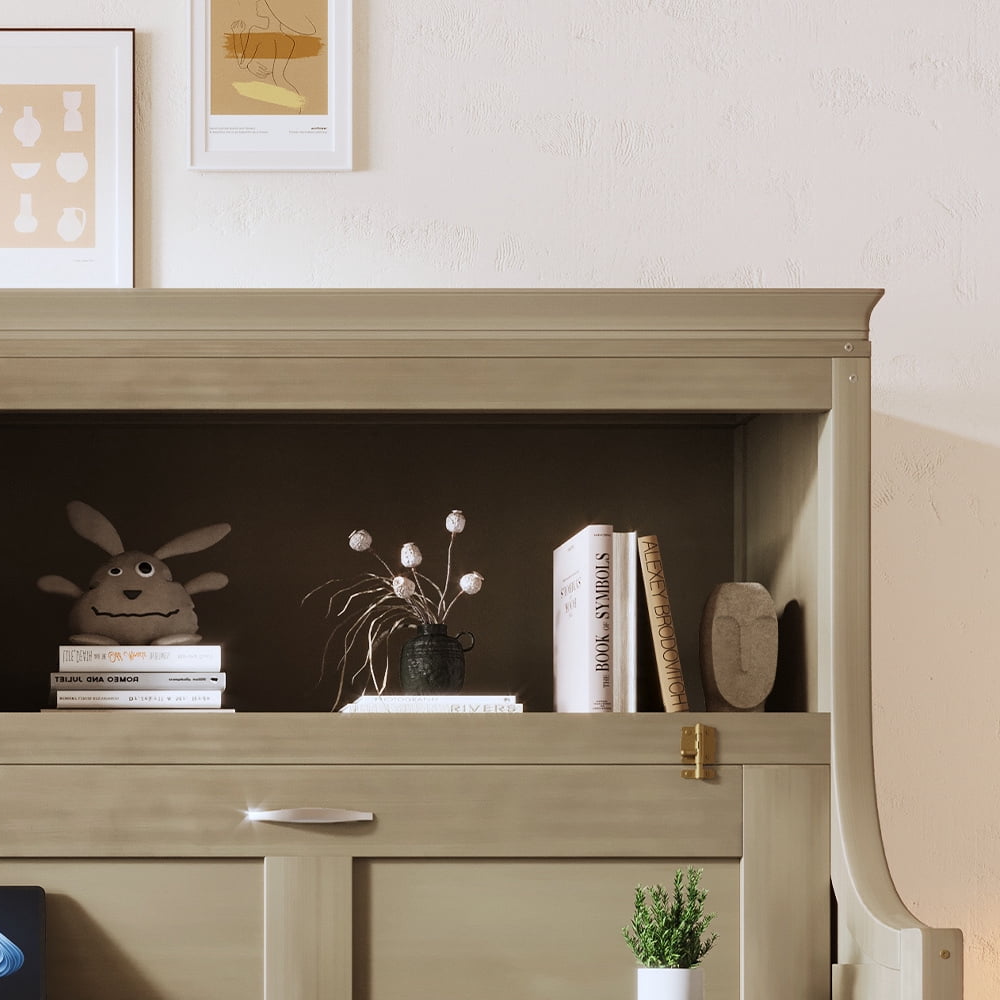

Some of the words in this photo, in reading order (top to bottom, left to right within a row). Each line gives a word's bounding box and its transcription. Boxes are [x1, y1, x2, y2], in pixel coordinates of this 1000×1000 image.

[595, 552, 610, 620] SYMBOLS
[641, 540, 668, 600] ALEXEY
[595, 634, 610, 672] BOOK
[653, 604, 687, 706] BRODOVITCH
[449, 704, 517, 713] RIVERS
